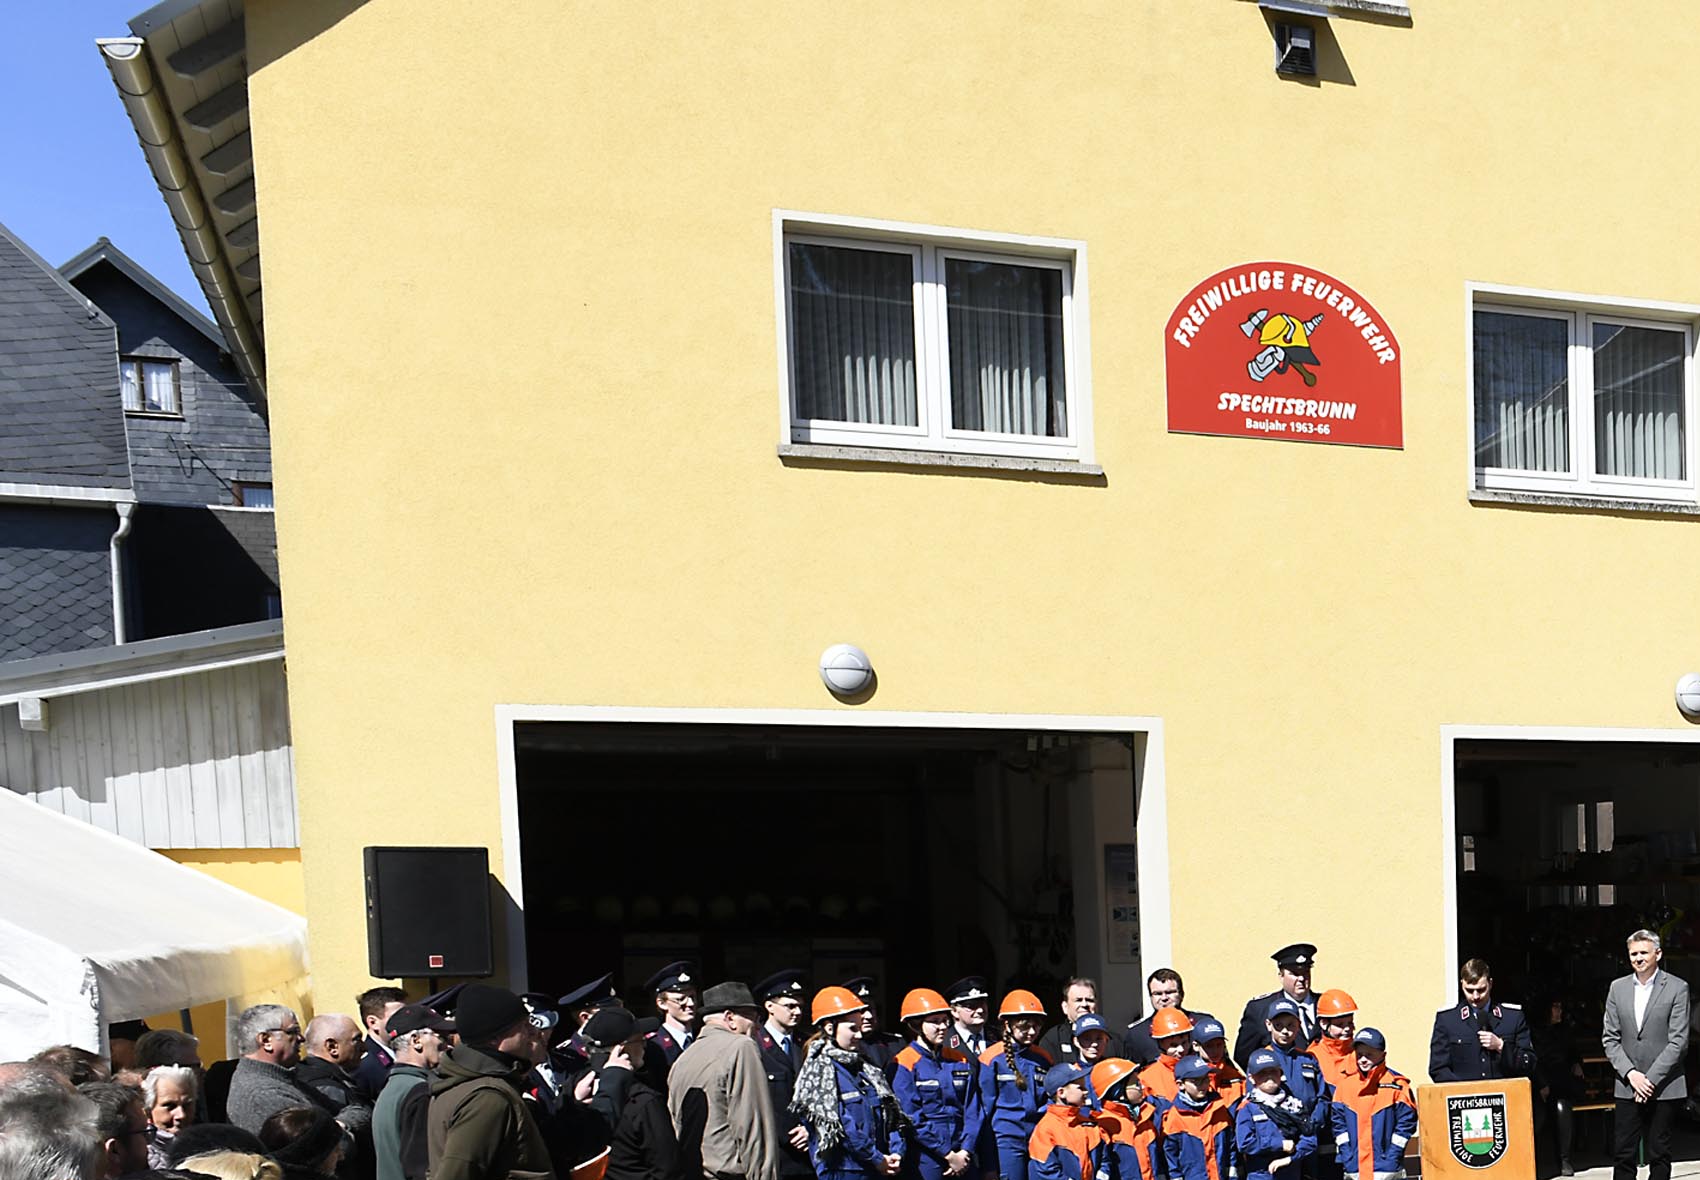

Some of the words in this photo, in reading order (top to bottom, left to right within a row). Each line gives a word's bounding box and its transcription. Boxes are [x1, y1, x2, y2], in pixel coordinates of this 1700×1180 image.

[1173, 270, 1285, 348] FREIWILLIGE
[1291, 273, 1396, 365] FEUERWEHR
[1217, 392, 1357, 420] SPECHTSBRUNN
[1246, 418, 1287, 433] Baujahr
[1290, 421, 1330, 435] 1963-66
